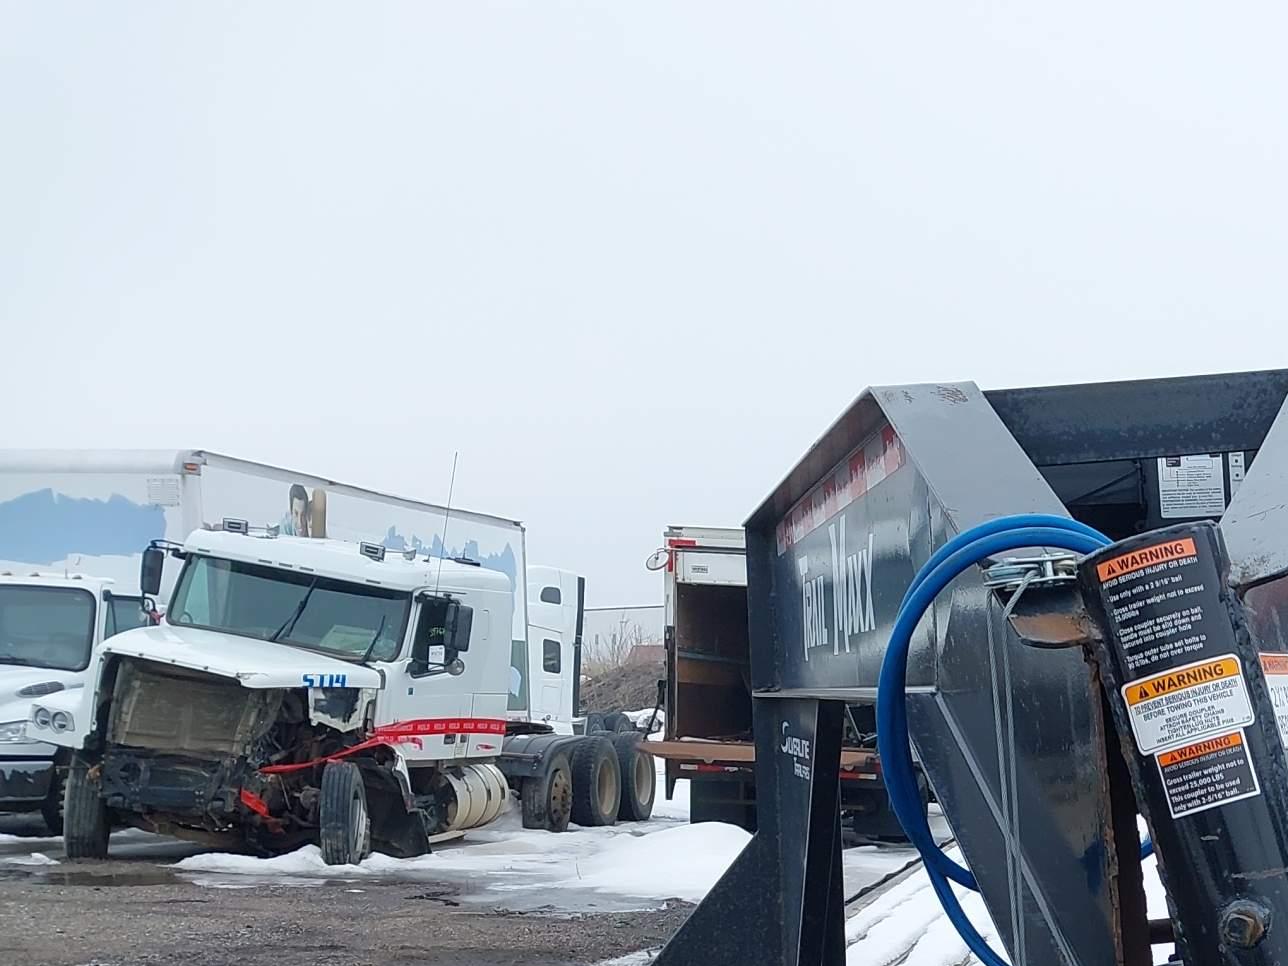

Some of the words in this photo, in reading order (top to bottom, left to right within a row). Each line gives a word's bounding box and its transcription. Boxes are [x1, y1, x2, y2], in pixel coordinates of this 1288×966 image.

[1116, 543, 1185, 571] WARNING
[1119, 569, 1145, 583] SERIOUS
[1168, 560, 1179, 569] OR
[1179, 556, 1198, 566] DEATH
[1146, 595, 1166, 605] weight
[1152, 664, 1224, 694] WARNING
[1141, 698, 1165, 713] PREVENT
[1166, 690, 1190, 706] SERIOUS
[1191, 685, 1211, 699] INJURY
[1212, 682, 1220, 691] OR
[1221, 678, 1238, 690] DEATH
[1143, 707, 1167, 722] BEFORE
[1167, 701, 1193, 716] TOWING
[1193, 697, 1208, 708] THIS
[1208, 689, 1234, 704] VEHICLE
[1160, 721, 1180, 731] ATTACH
[1181, 715, 1202, 726] SAFETY
[1165, 712, 1187, 723] SECURE
[1188, 705, 1215, 716] COUPLER
[1168, 724, 1189, 735] TIGHTEN
[1189, 720, 1202, 729] LUG
[1204, 716, 1220, 726] NUTS
[1175, 731, 1186, 739] ALL
[1186, 722, 1221, 737] APPLICABLE
[1178, 737, 1231, 759] WARNING
[1167, 777, 1183, 786] Gross
[1183, 770, 1202, 781] trailer
[1203, 763, 1226, 775] weight
[1169, 784, 1189, 795] exceed
[1190, 777, 1211, 788] 25,000
[1211, 773, 1224, 783] LBS
[1171, 794, 1184, 803] This
[1184, 788, 1207, 800] coupler
[1225, 777, 1240, 787] used
[1174, 803, 1186, 812] only
[1187, 798, 1201, 808] with
